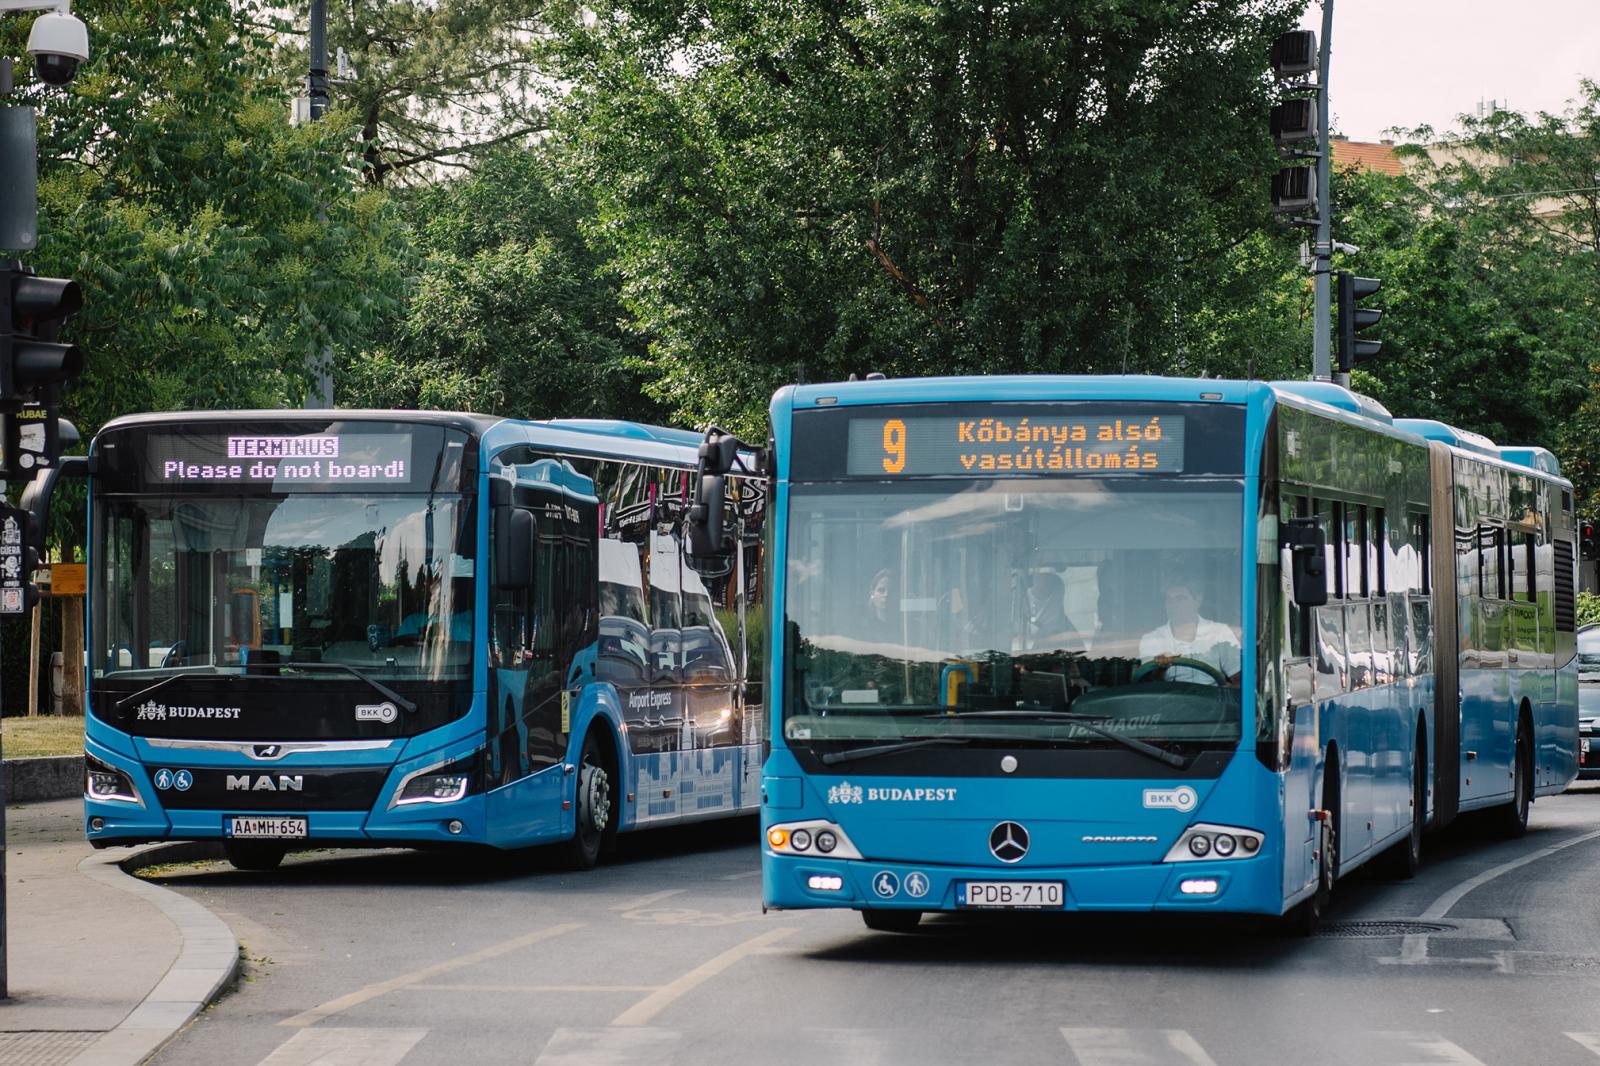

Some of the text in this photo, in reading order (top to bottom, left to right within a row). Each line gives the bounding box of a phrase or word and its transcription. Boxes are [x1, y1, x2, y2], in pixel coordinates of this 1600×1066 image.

[959, 417, 1161, 443] Kőbánya alsó
[231, 438, 336, 456] TERMINUS
[883, 419, 906, 473] 9
[960, 443, 1158, 470] vasútállomás
[164, 461, 404, 478] Please do not board!
[628, 690, 672, 713] Airport Express
[168, 706, 241, 719] BUDAPEST
[361, 708, 379, 717] BKK
[226, 775, 303, 791] MAN
[867, 787, 957, 801] BUDAPEST
[1150, 794, 1173, 803] BKK
[971, 885, 1058, 902] PDB-710
